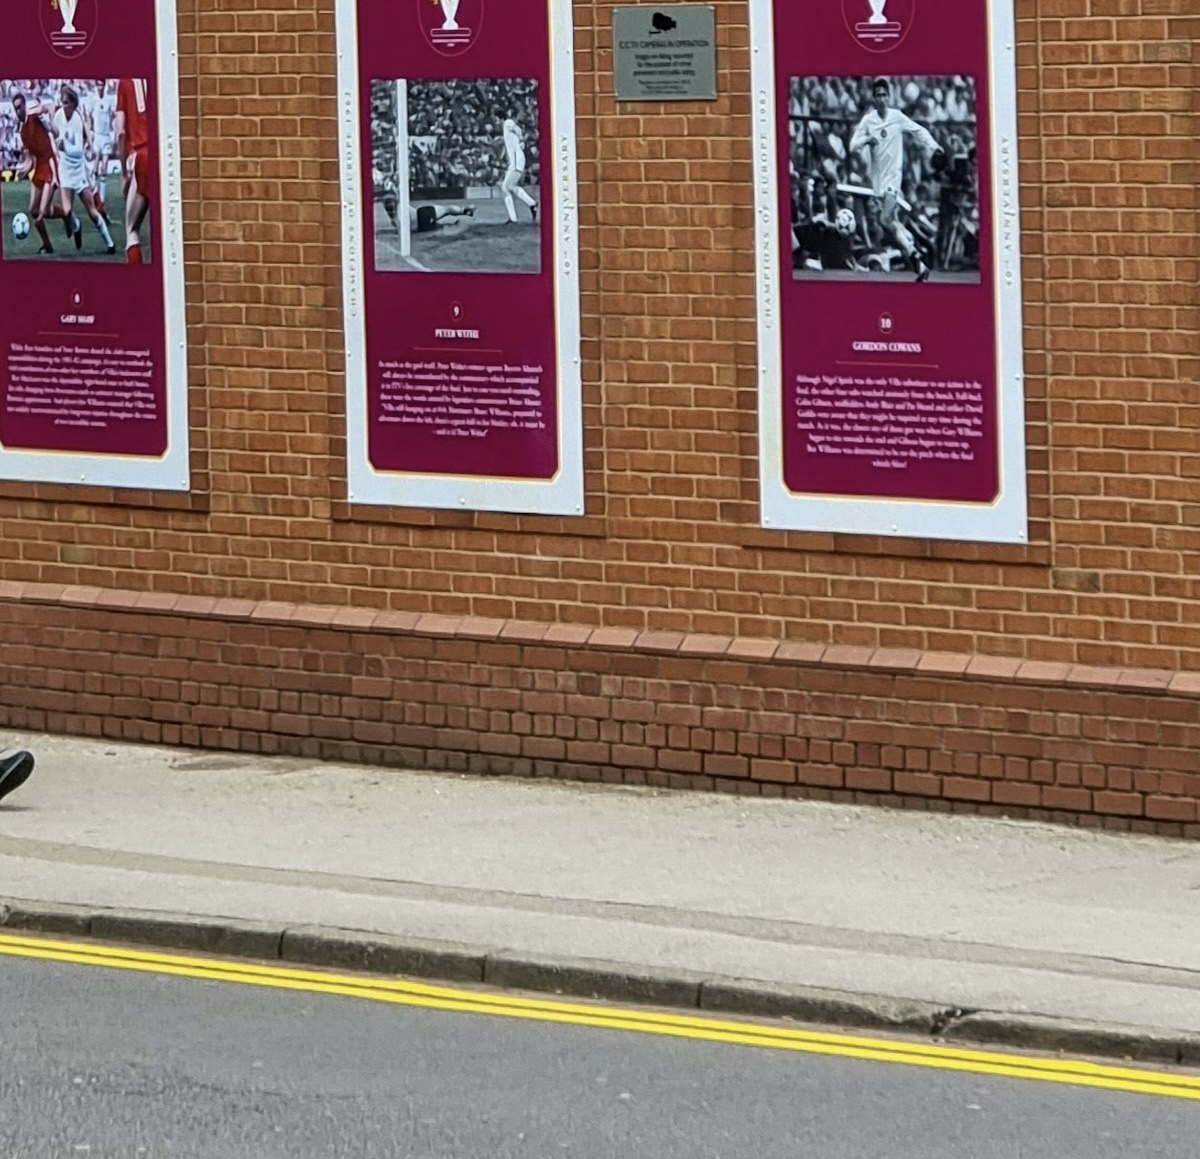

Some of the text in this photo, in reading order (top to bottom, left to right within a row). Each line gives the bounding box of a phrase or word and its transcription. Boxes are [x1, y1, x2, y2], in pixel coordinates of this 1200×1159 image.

[759, 132, 769, 195] EUROPE
[1002, 135, 1012, 253] ANNIVERSARY
[881, 318, 892, 329] 10
